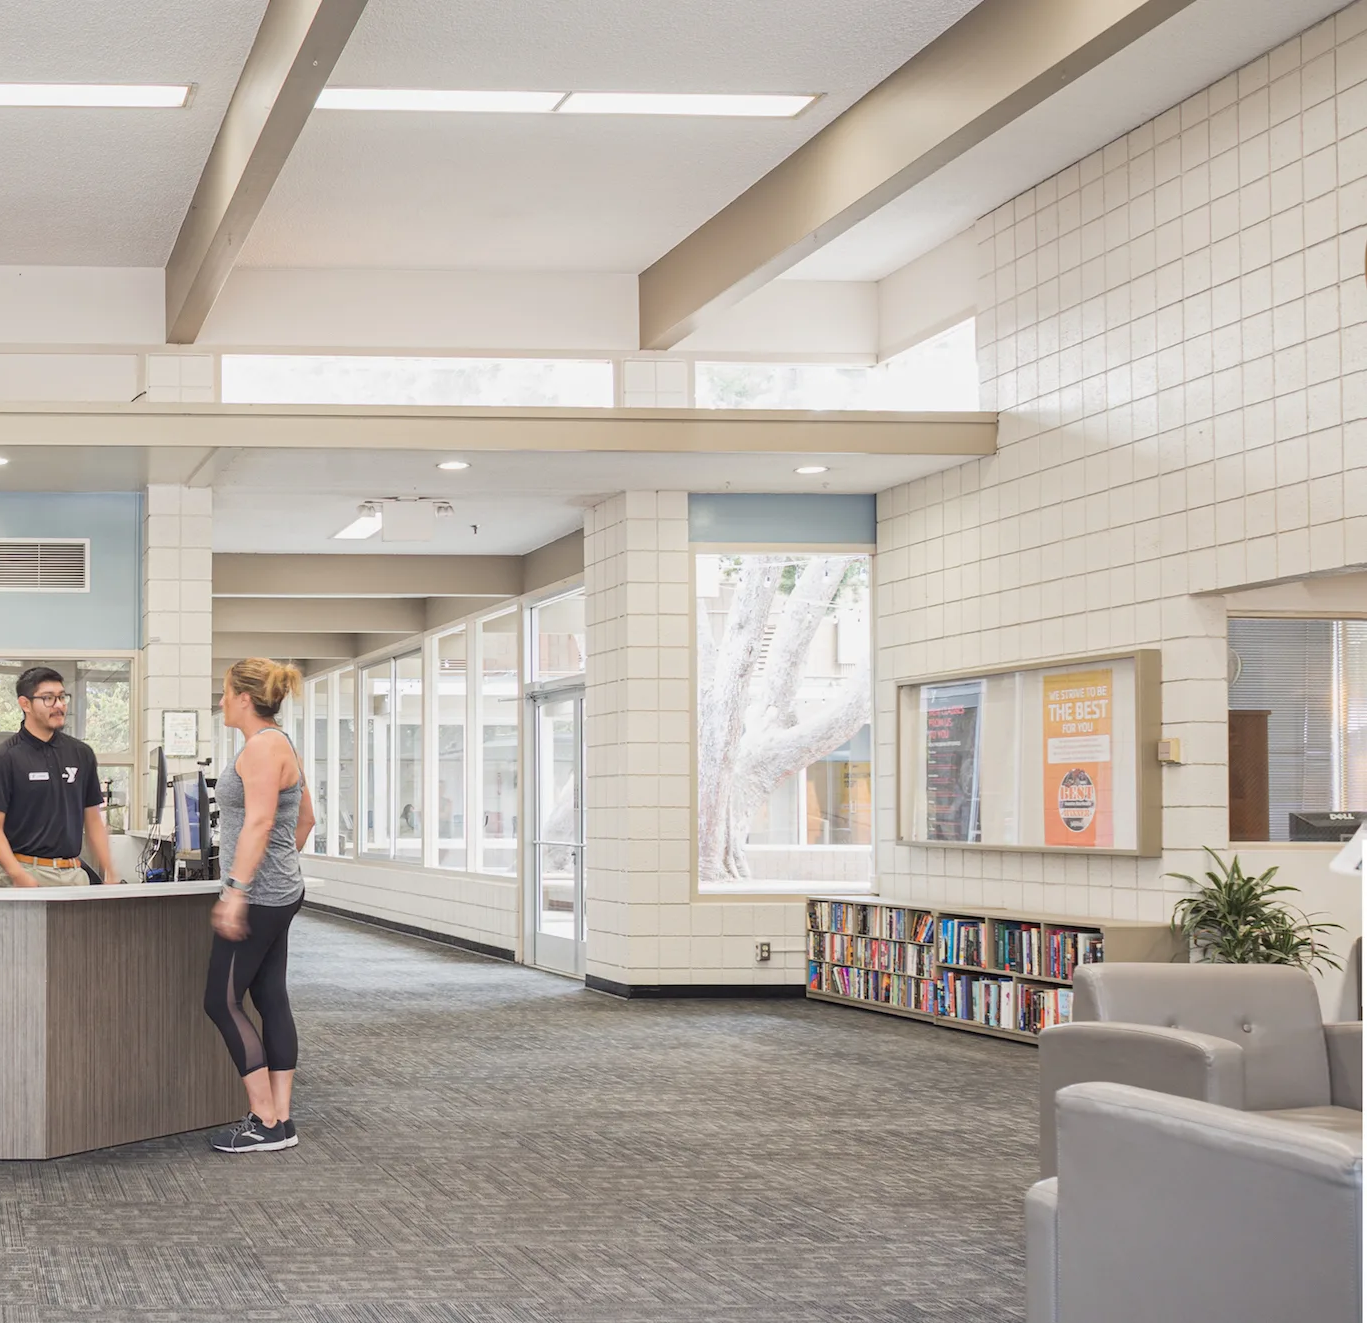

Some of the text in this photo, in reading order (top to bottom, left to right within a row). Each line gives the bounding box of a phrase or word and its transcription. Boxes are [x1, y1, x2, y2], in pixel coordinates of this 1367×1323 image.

[1086, 687, 1095, 697] TO
[1097, 686, 1107, 696] BE
[1048, 700, 1109, 721] THE BEST
[1062, 722, 1093, 733] FOR YOU
[1060, 786, 1093, 800] BEST
